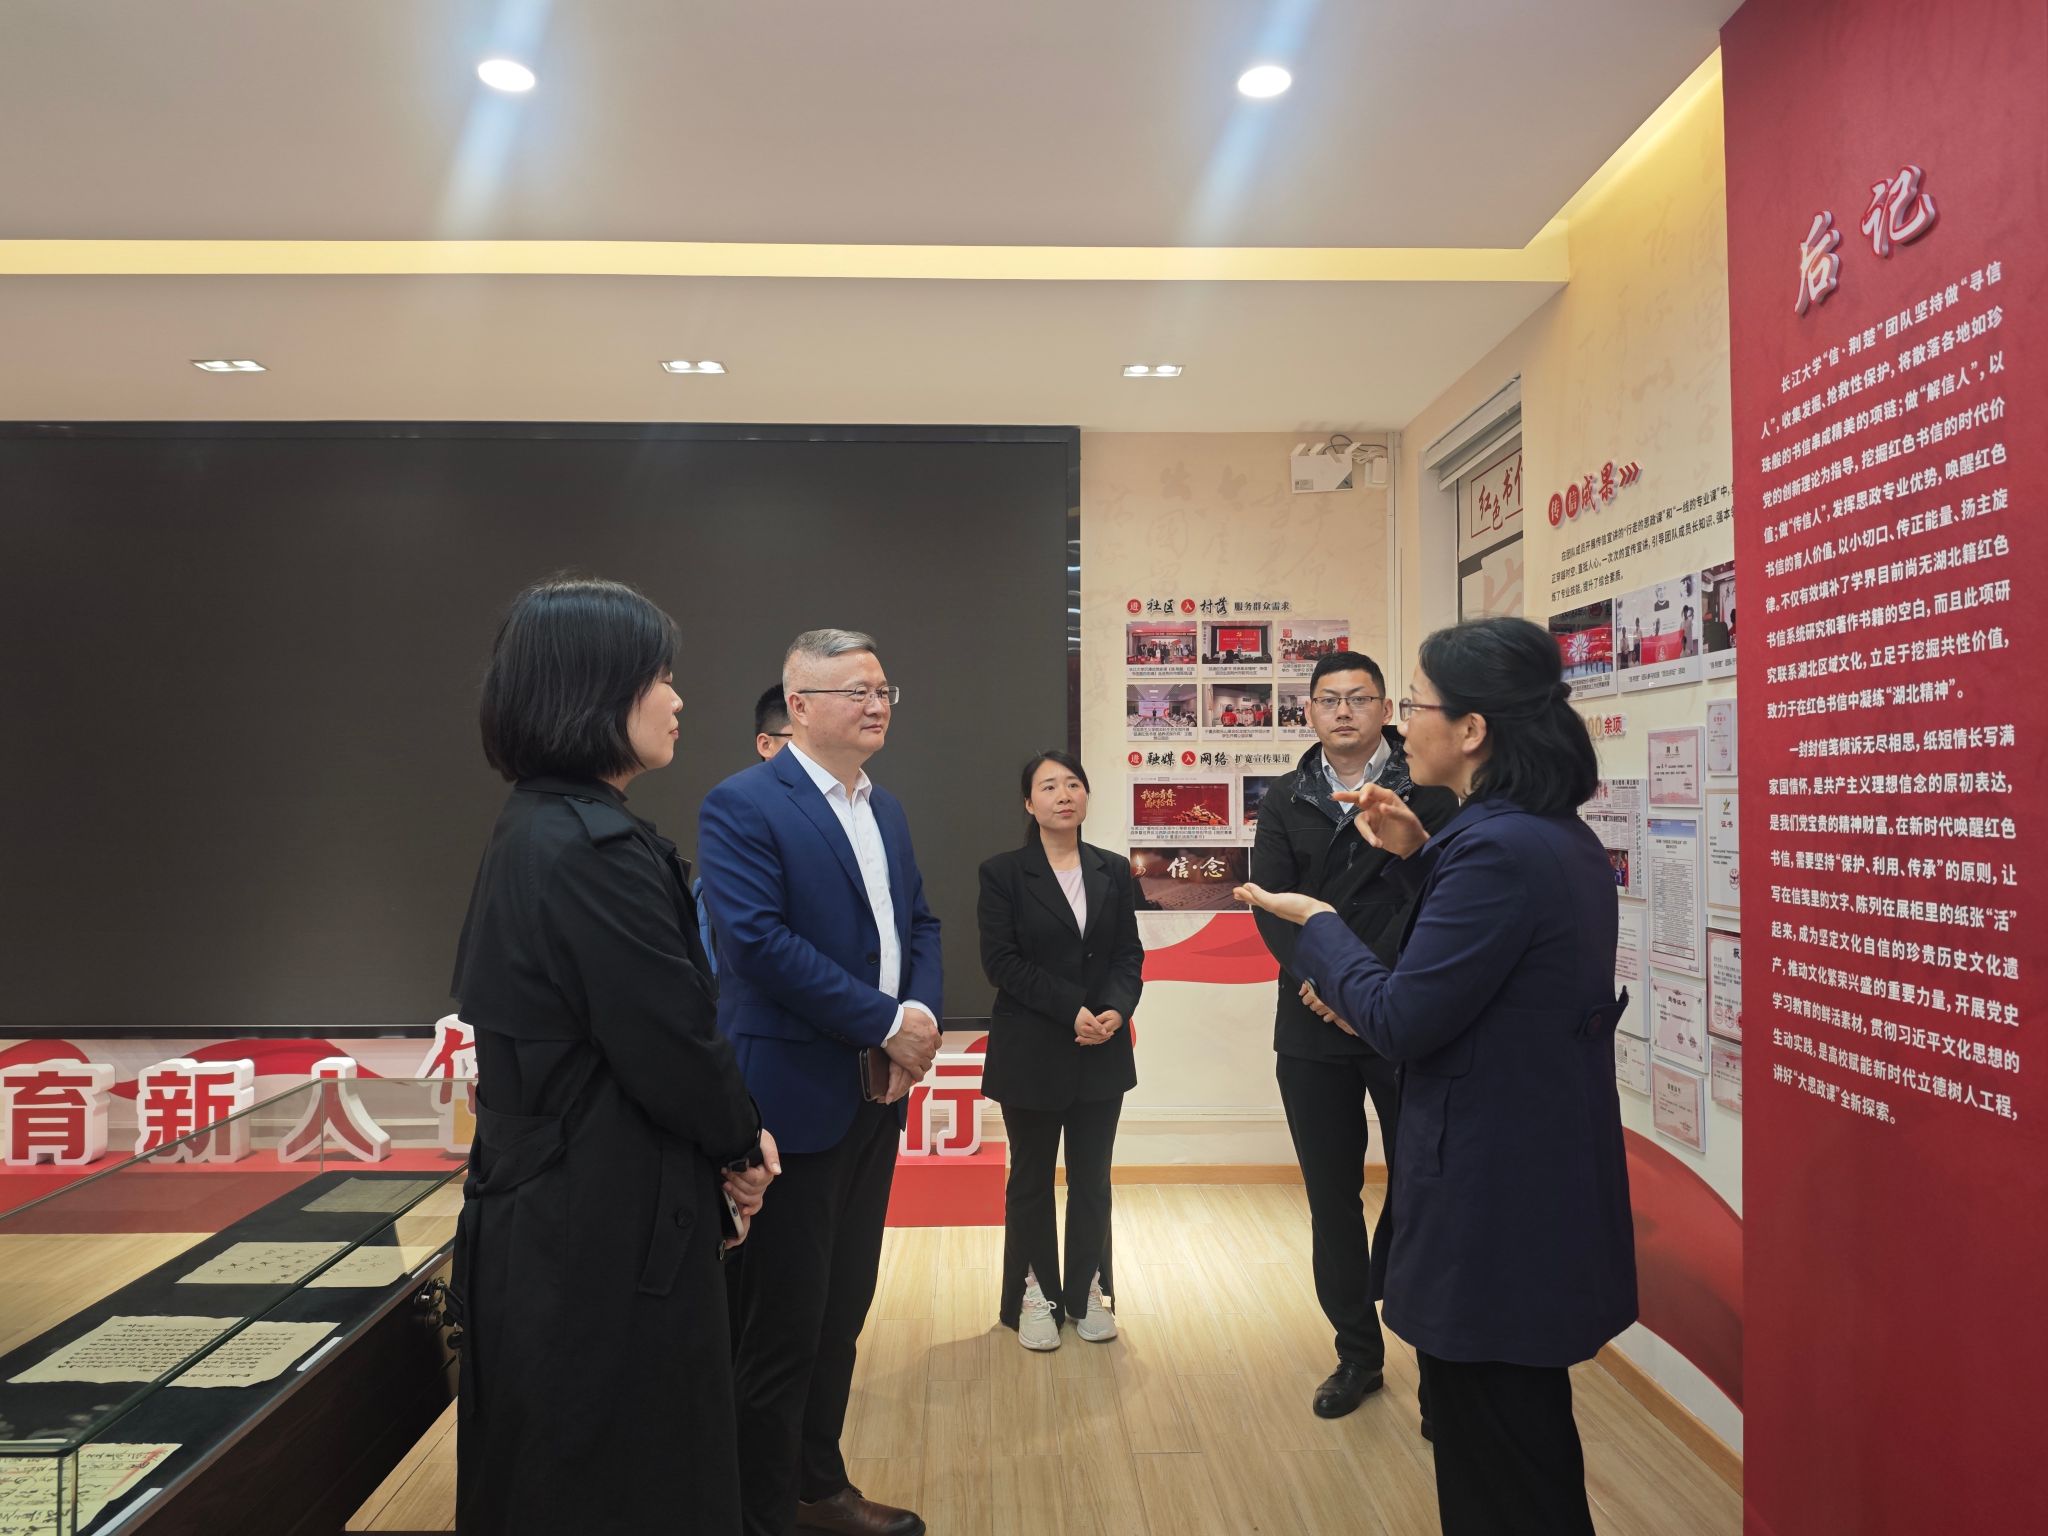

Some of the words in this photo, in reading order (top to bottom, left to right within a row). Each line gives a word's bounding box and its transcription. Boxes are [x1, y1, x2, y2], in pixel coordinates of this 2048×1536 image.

[1795, 165, 1935, 314] 后记
[1548, 461, 1614, 527] 传信成果
[1234, 601, 1290, 611] 服务群众需求
[1234, 754, 1290, 764] 扩宽宣传渠道
[4, 1066, 384, 1162] 育新人
